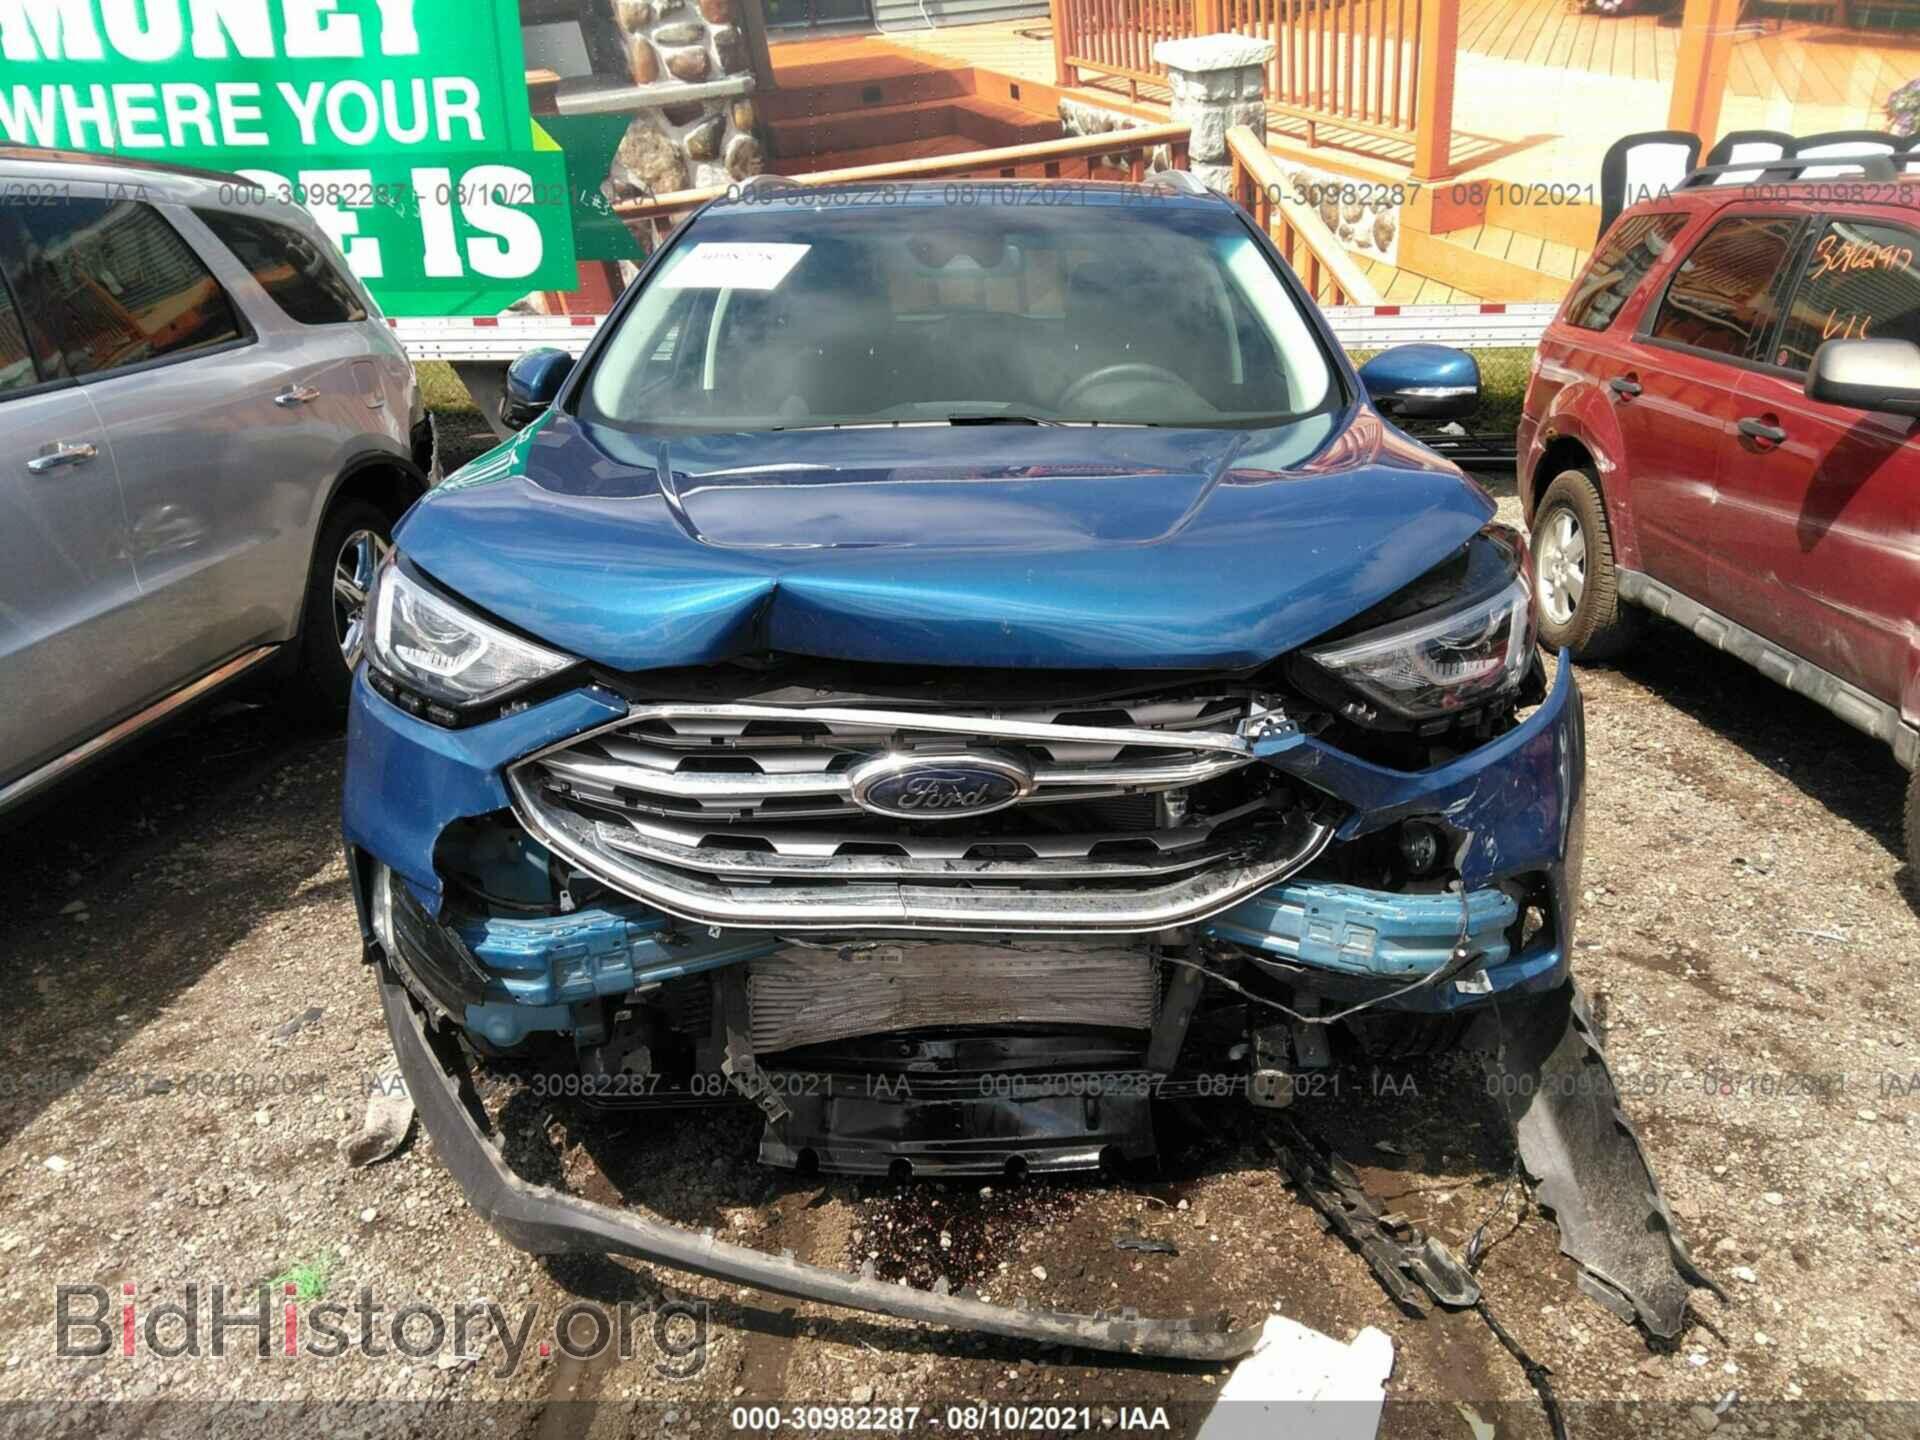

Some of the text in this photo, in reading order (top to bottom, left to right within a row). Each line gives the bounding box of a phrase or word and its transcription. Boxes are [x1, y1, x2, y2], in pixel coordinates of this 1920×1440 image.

[0, 76, 485, 149] WHERE YOUR
[411, 164, 543, 279] IS
[897, 776, 990, 809] Ford
